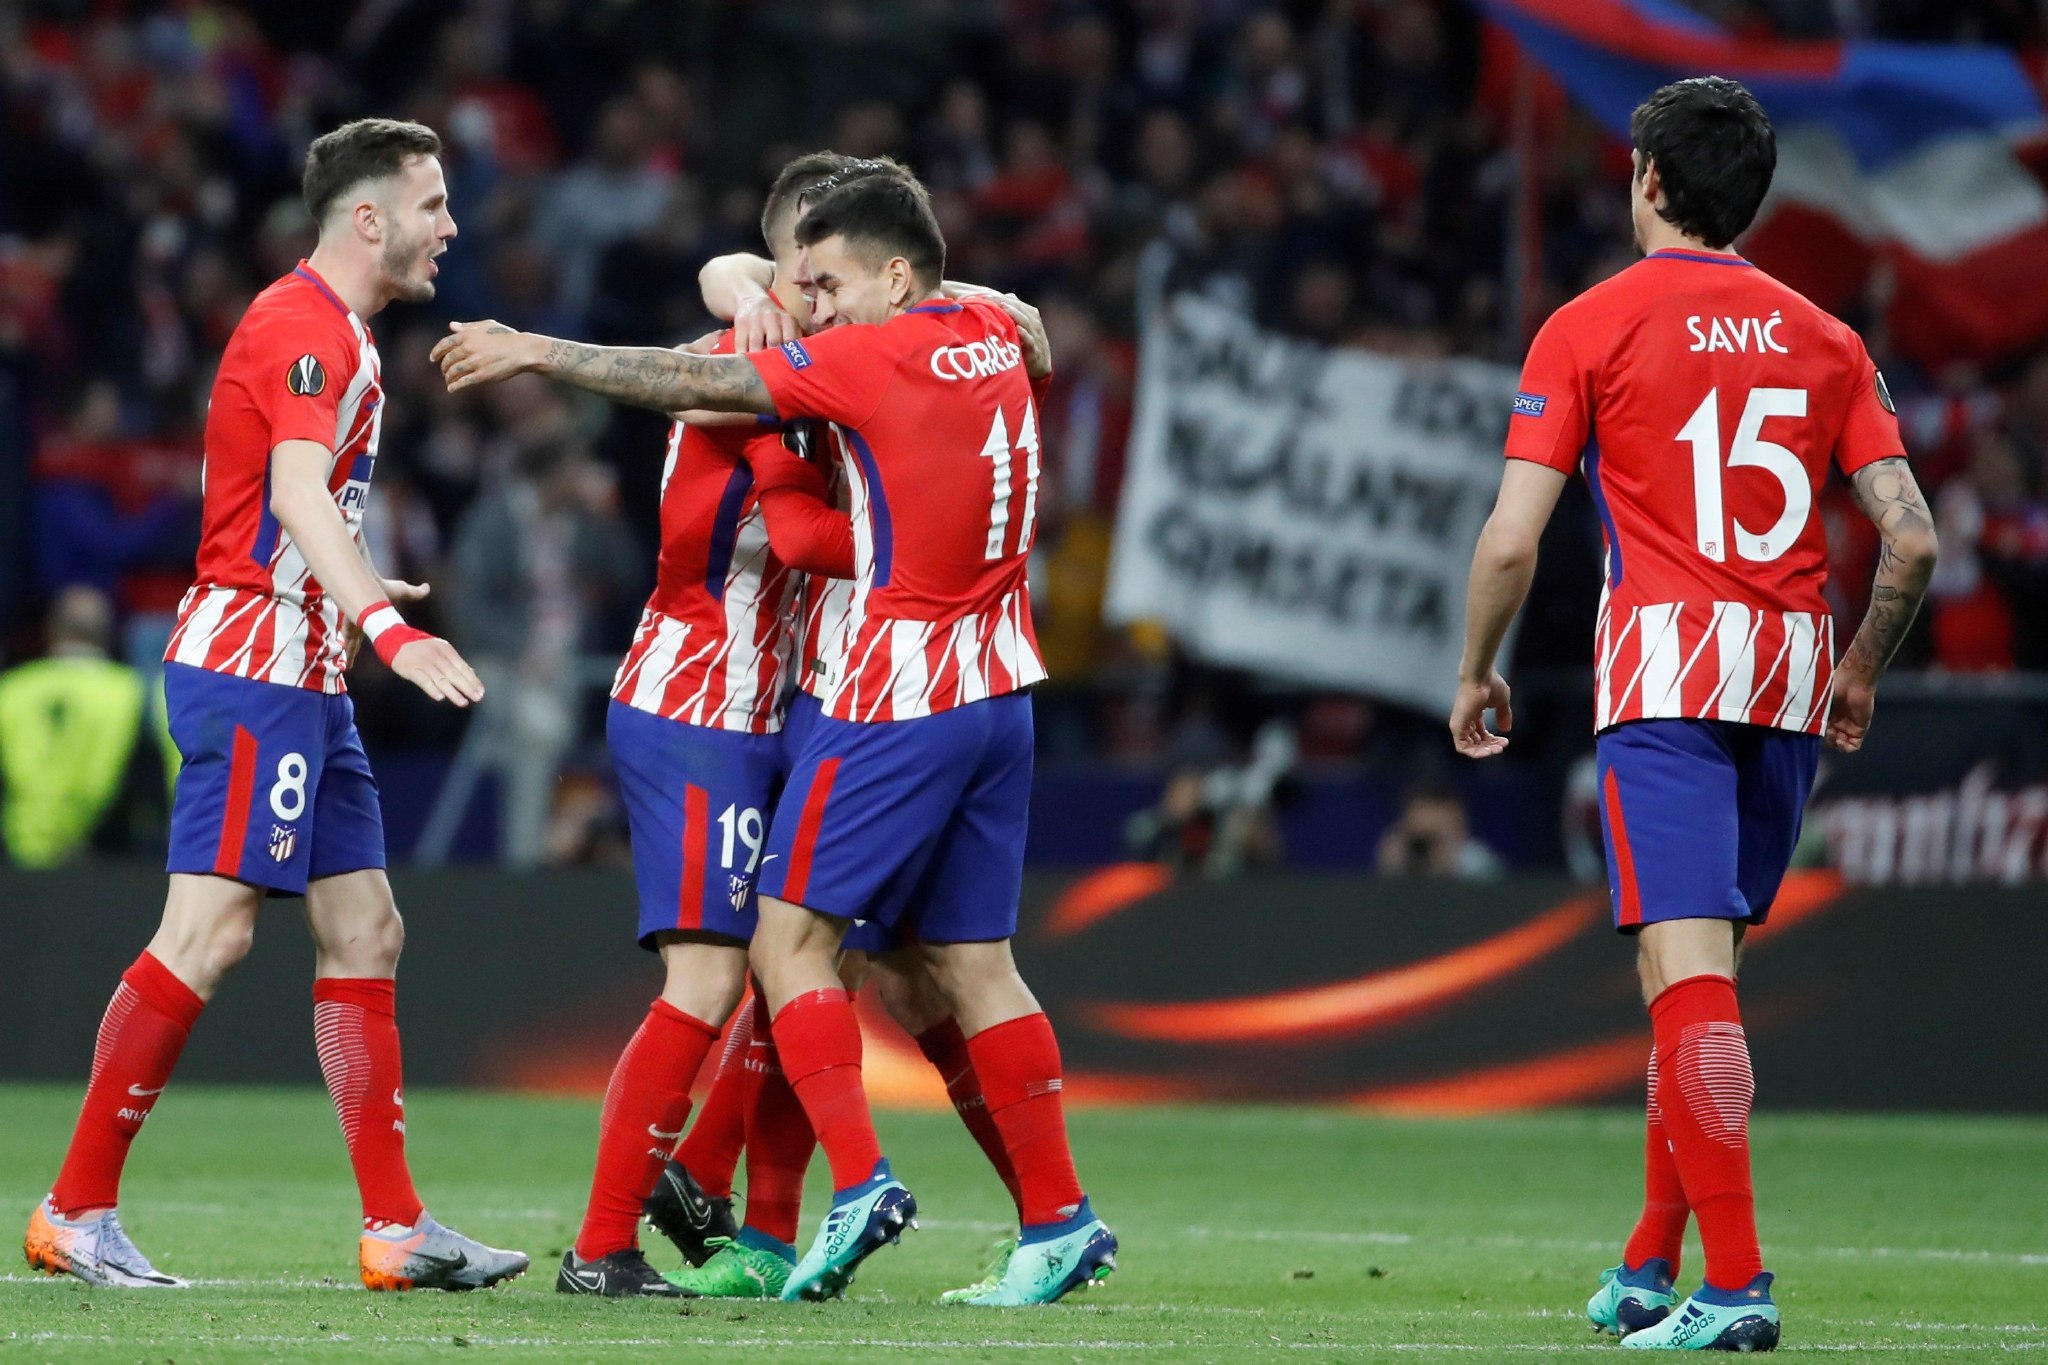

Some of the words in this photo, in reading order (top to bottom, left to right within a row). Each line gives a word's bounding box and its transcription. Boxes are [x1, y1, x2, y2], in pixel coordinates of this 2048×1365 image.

[1686, 309, 1788, 354] SAVIĆ
[979, 396, 1040, 560] 11
[1674, 386, 1812, 563] 15
[269, 752, 308, 821] 8
[717, 803, 764, 874] 19
[828, 1206, 861, 1255] adidas
[1671, 1313, 1716, 1347] adidas
